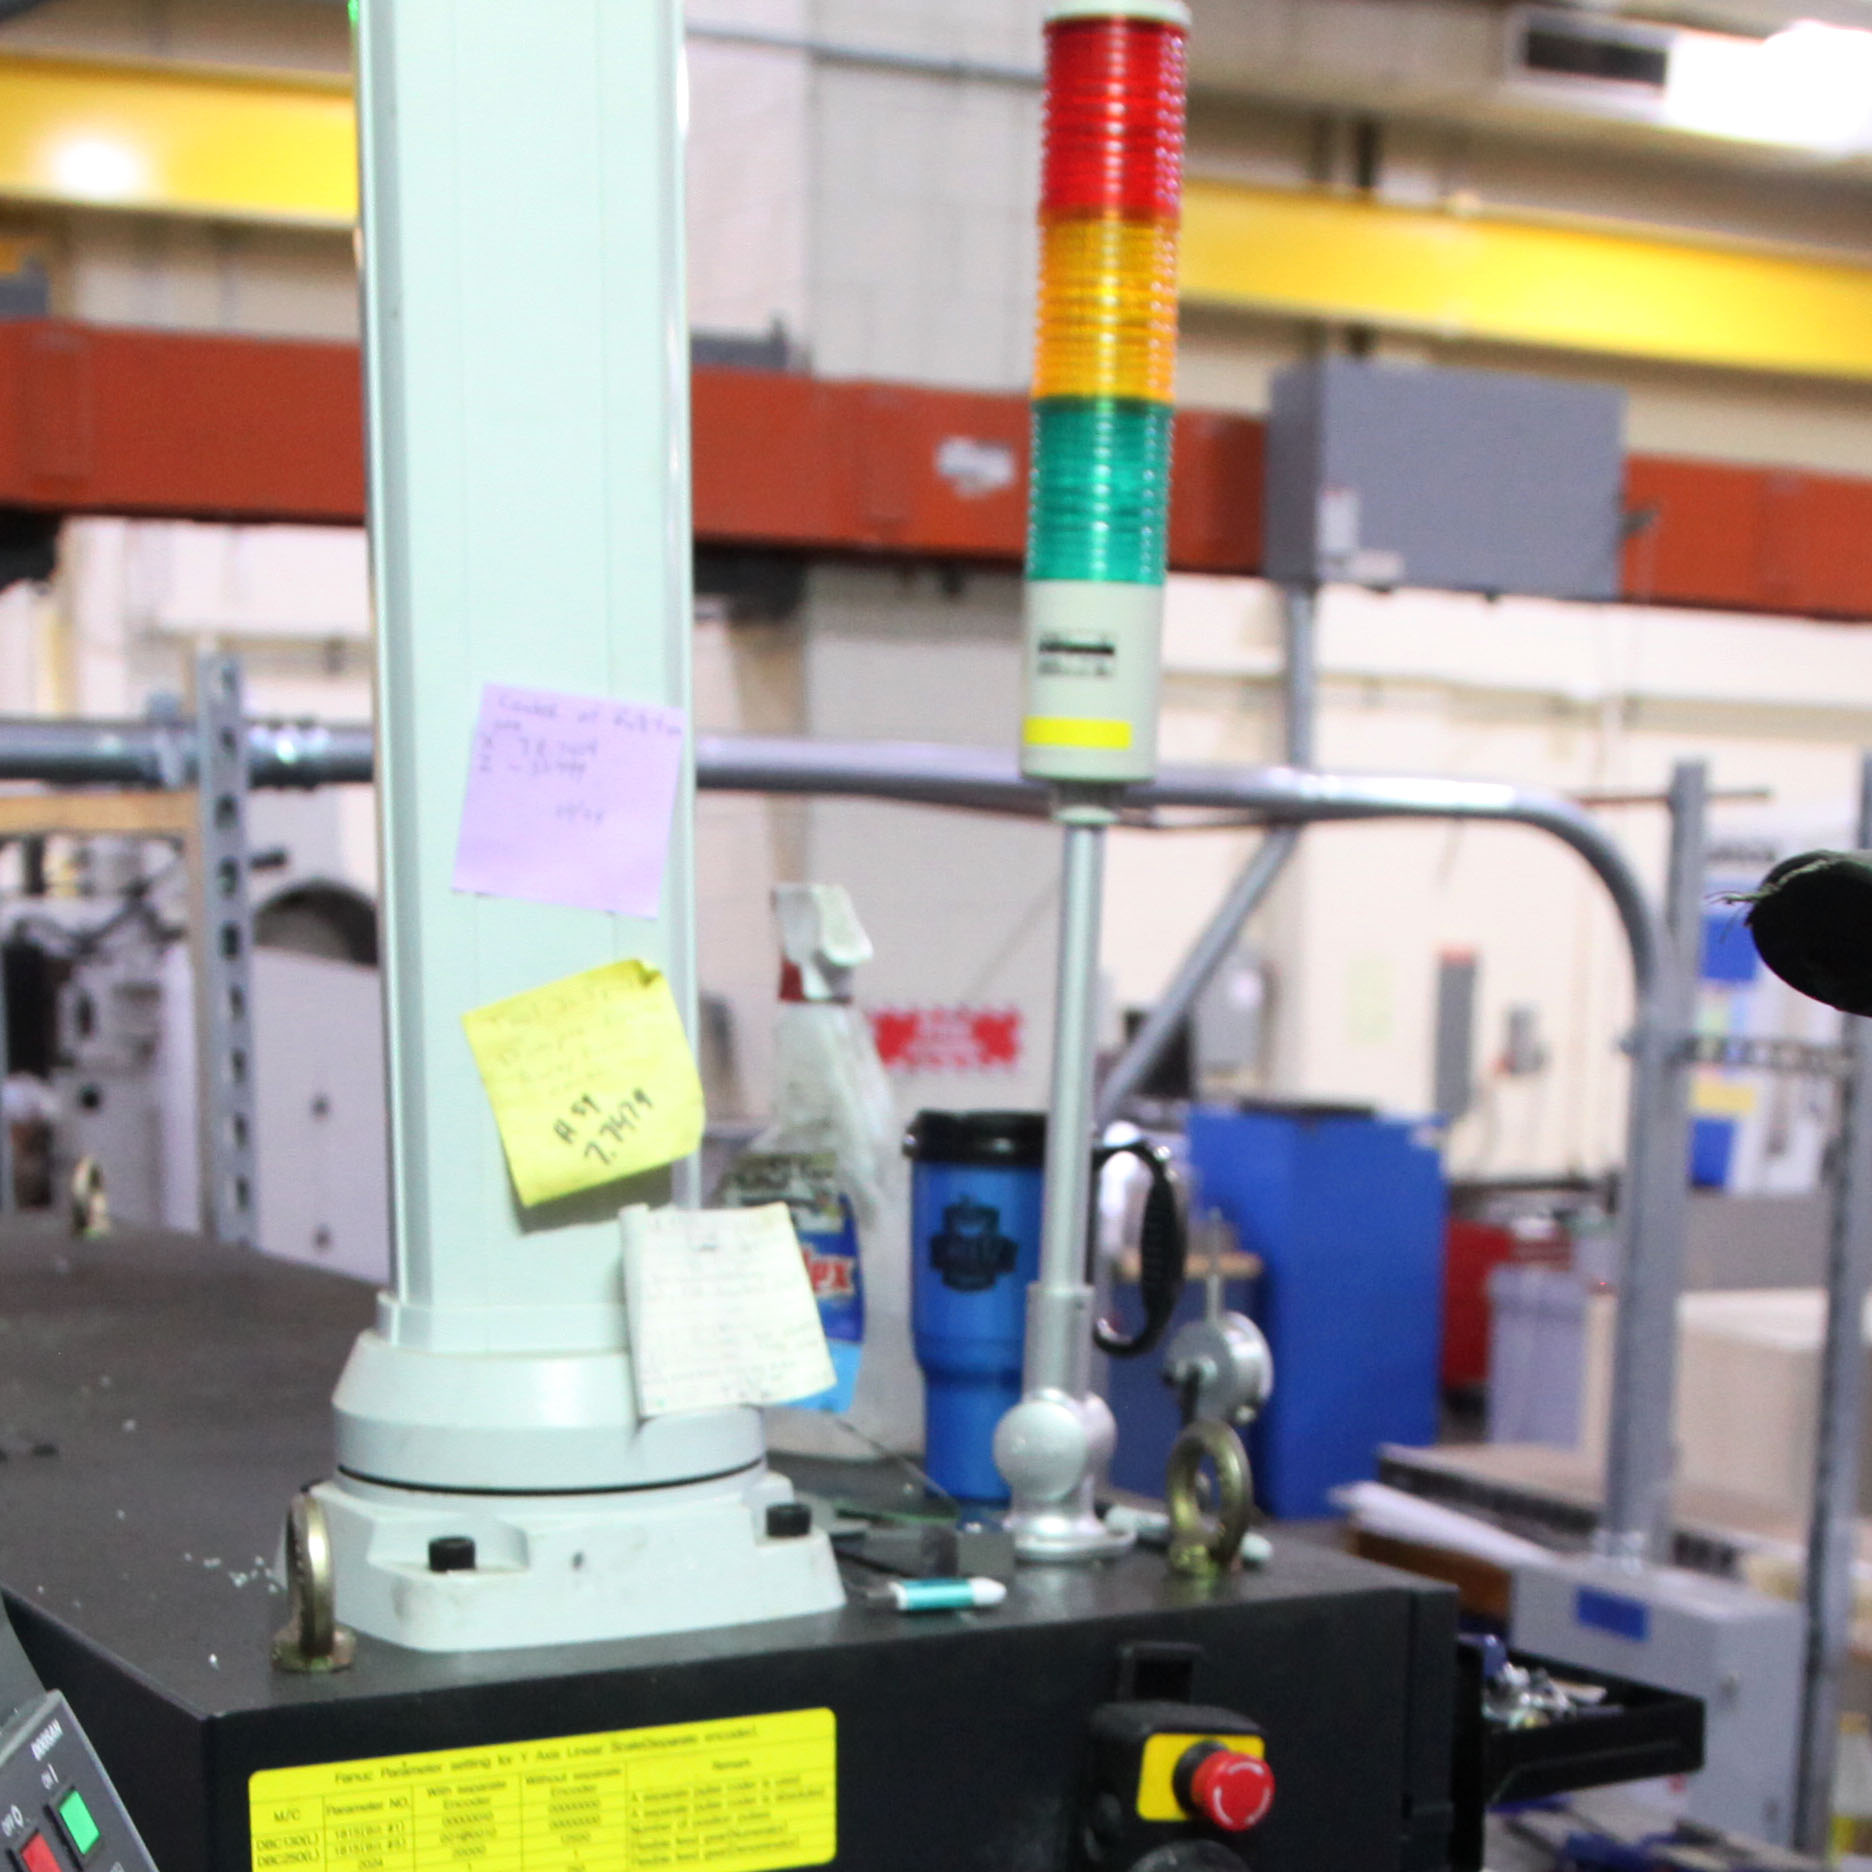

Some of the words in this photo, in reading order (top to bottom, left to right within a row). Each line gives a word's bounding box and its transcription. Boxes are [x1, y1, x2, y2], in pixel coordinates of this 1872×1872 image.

[334, 1770, 373, 1784] Fanuc
[450, 1754, 492, 1773] setting
[536, 1749, 561, 1761] Axis
[567, 1744, 603, 1758] Linear
[427, 1785, 453, 1798] With
